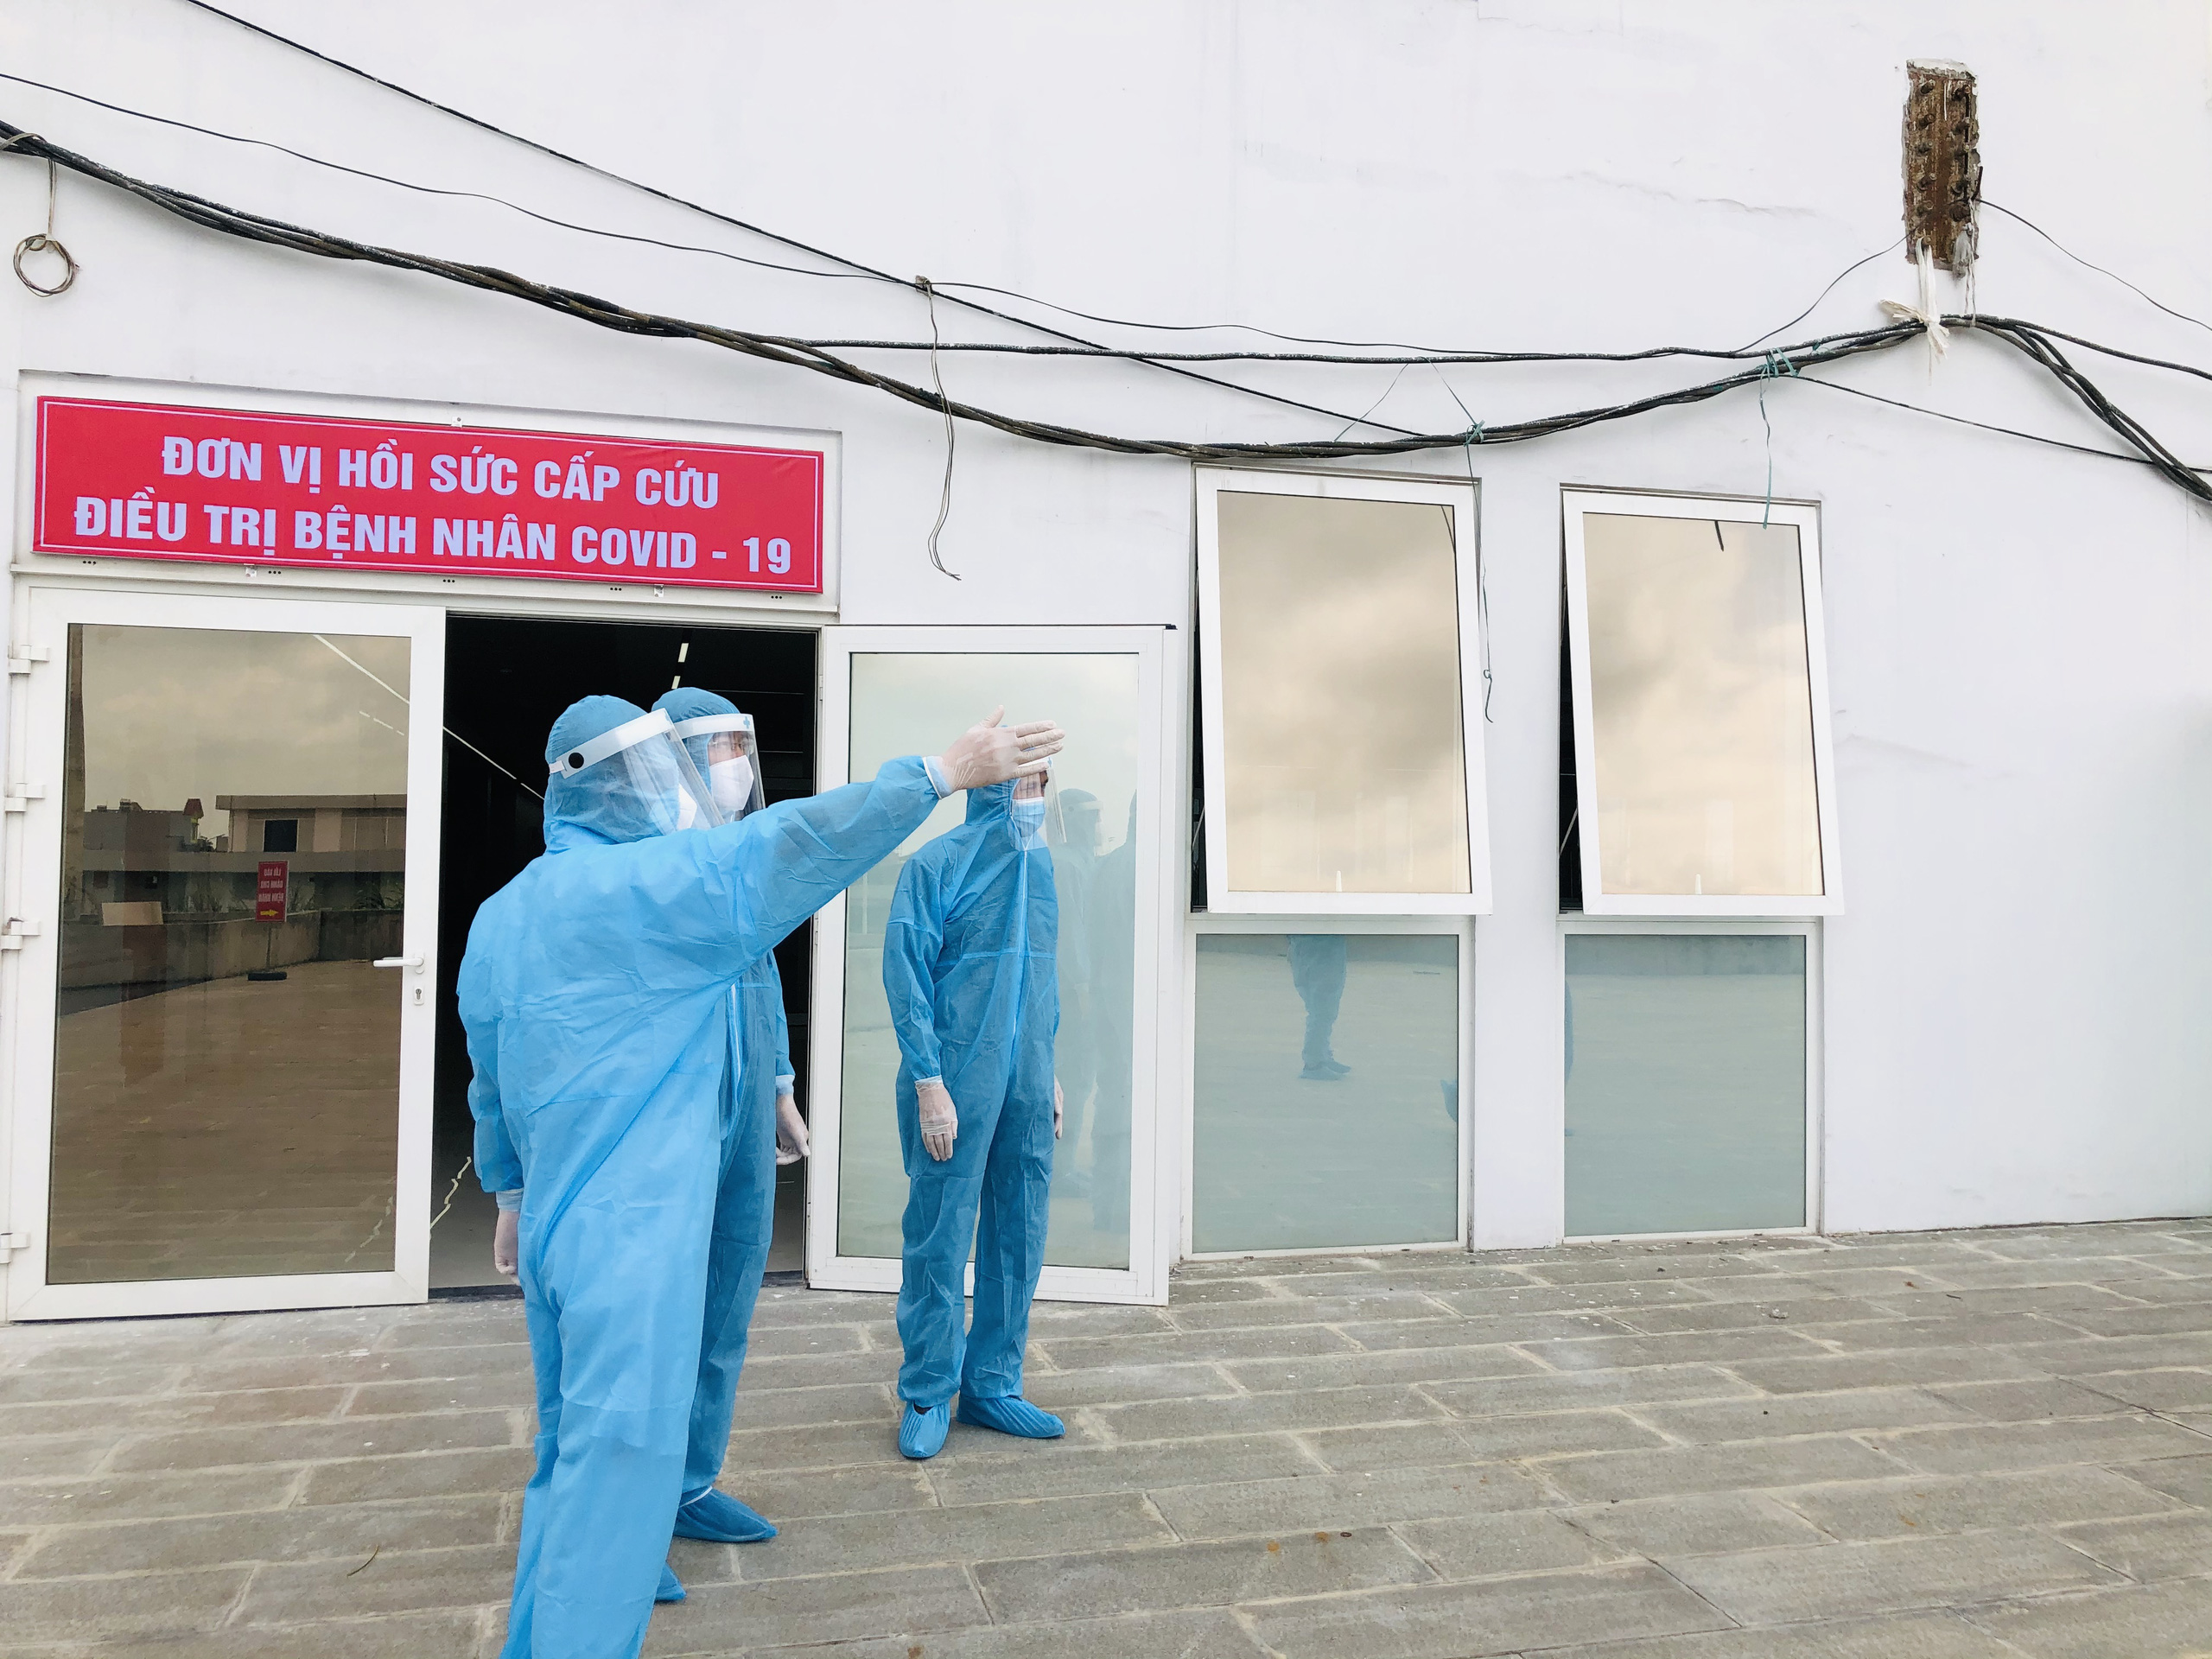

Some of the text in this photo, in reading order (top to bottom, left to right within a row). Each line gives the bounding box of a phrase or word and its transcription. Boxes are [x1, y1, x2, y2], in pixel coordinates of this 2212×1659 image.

[162, 435, 719, 509] ĐƠN VỊ HỒI SỨC CẤP CỨU
[74, 486, 791, 575] ĐIỀU TRỊ BỆNH NHÂN COVID - 19
